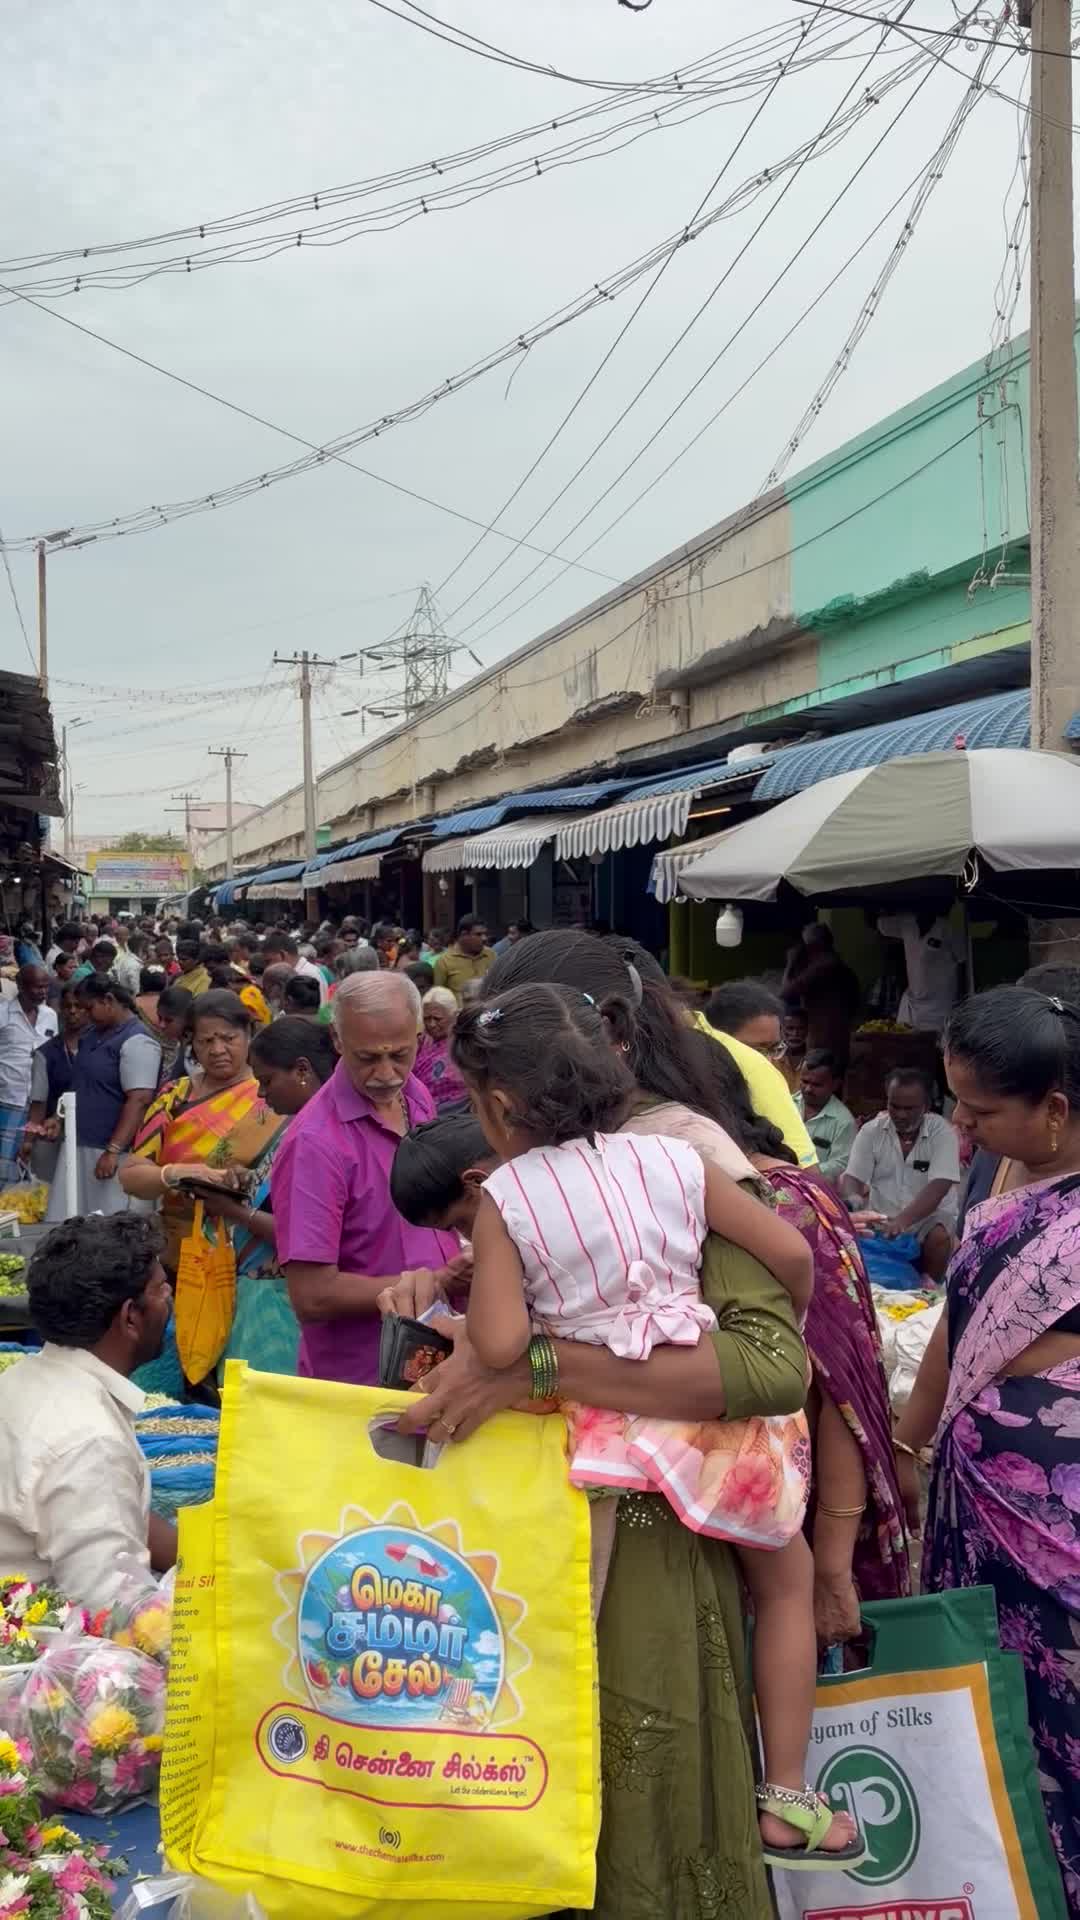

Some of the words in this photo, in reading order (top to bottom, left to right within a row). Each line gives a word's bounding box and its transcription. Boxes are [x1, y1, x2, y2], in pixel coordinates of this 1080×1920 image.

[351, 1564, 442, 1617] மெகா
[326, 1604, 468, 1664] சம்மர்
[352, 1650, 442, 1697] சேல்
[860, 1711, 879, 1736] of
[887, 1706, 933, 1728] Silks
[313, 1735, 329, 1761] தி
[336, 1742, 435, 1778] சென்னை
[443, 1752, 526, 1782] சில்க்ஸ்
